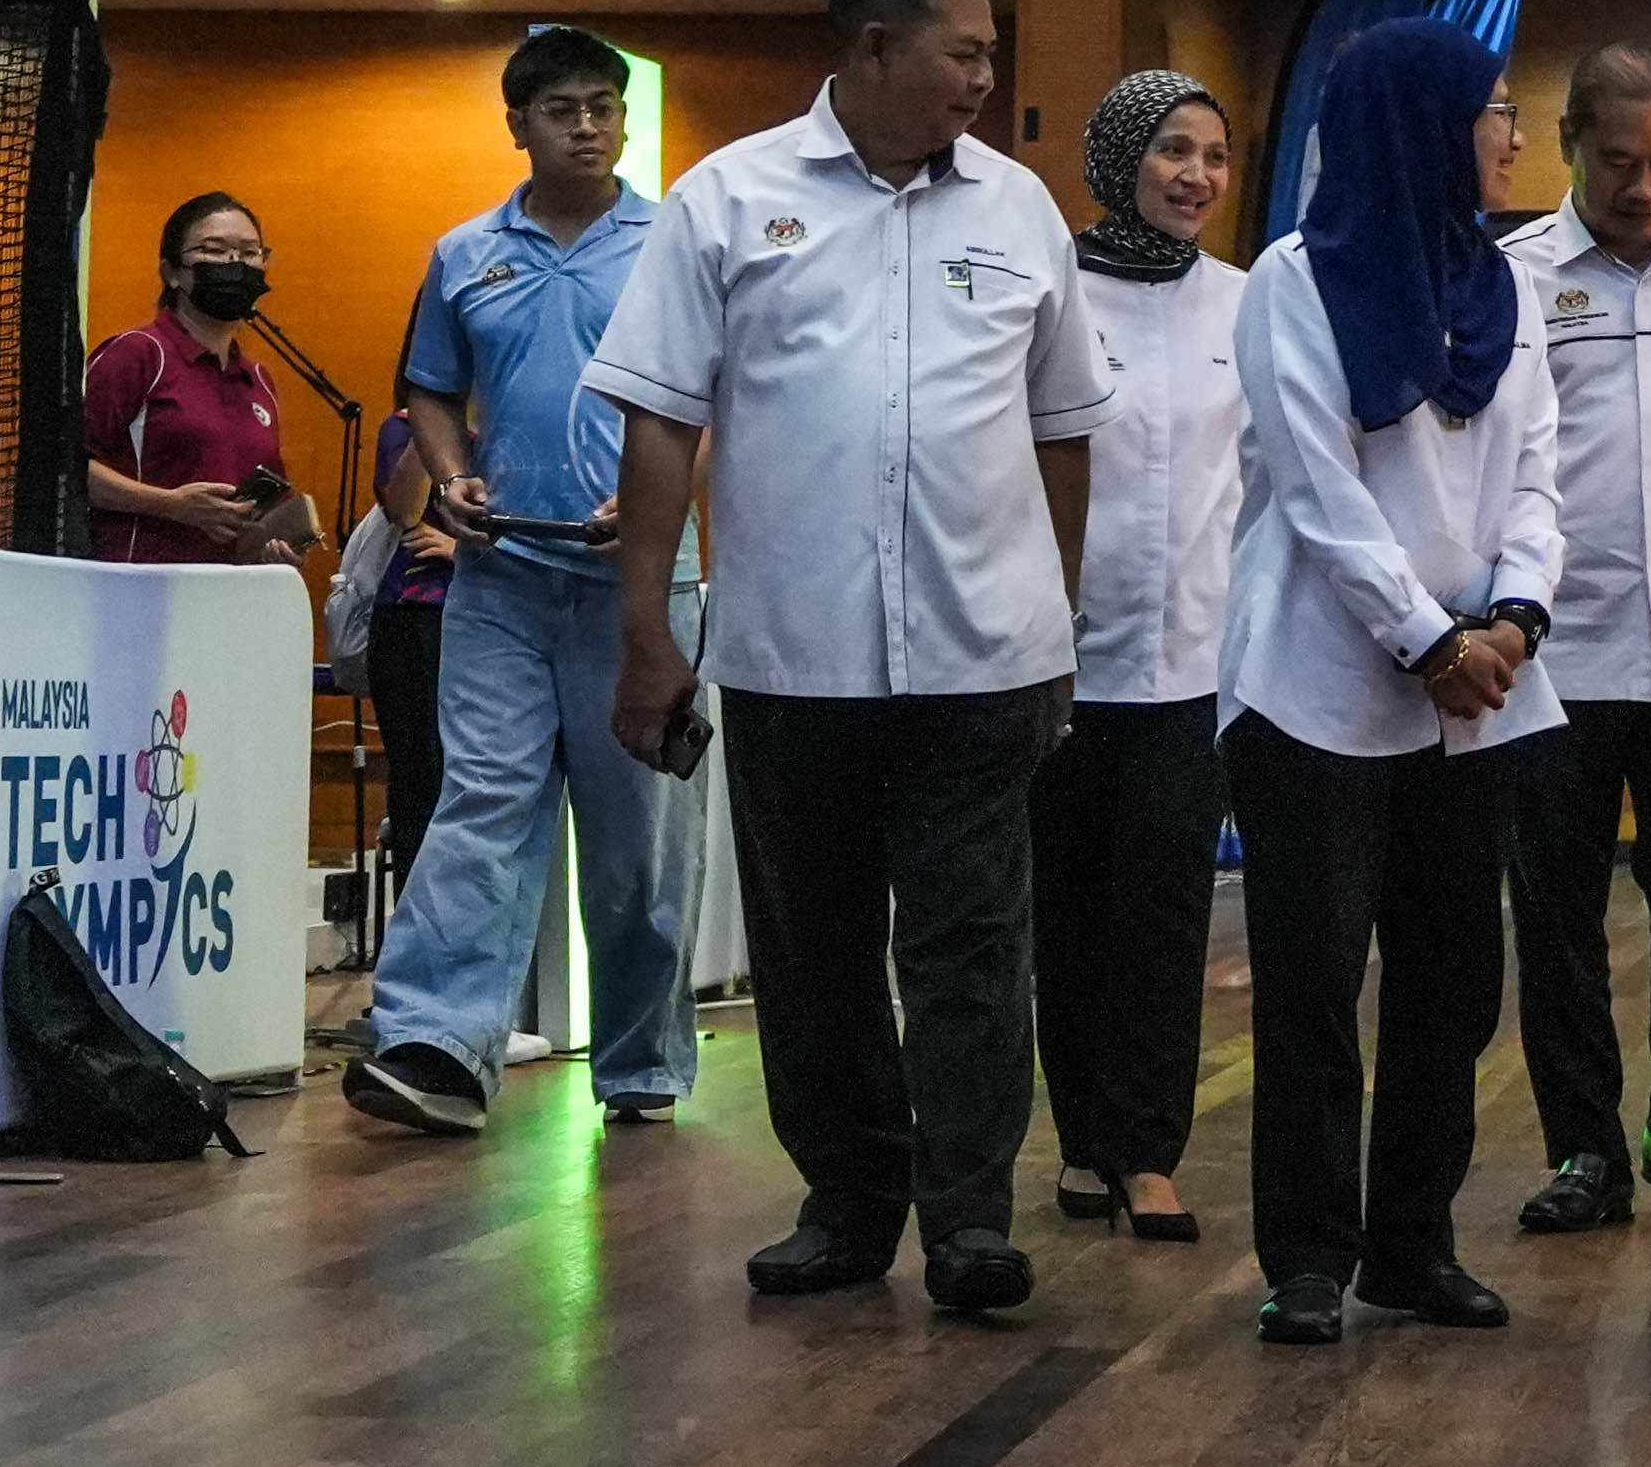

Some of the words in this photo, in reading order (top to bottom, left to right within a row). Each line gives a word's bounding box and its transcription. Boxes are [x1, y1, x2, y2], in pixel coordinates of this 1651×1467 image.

[1, 678, 90, 730] MALAYSIA
[1, 753, 127, 870] TECH
[53, 869, 234, 990] YMPICS
